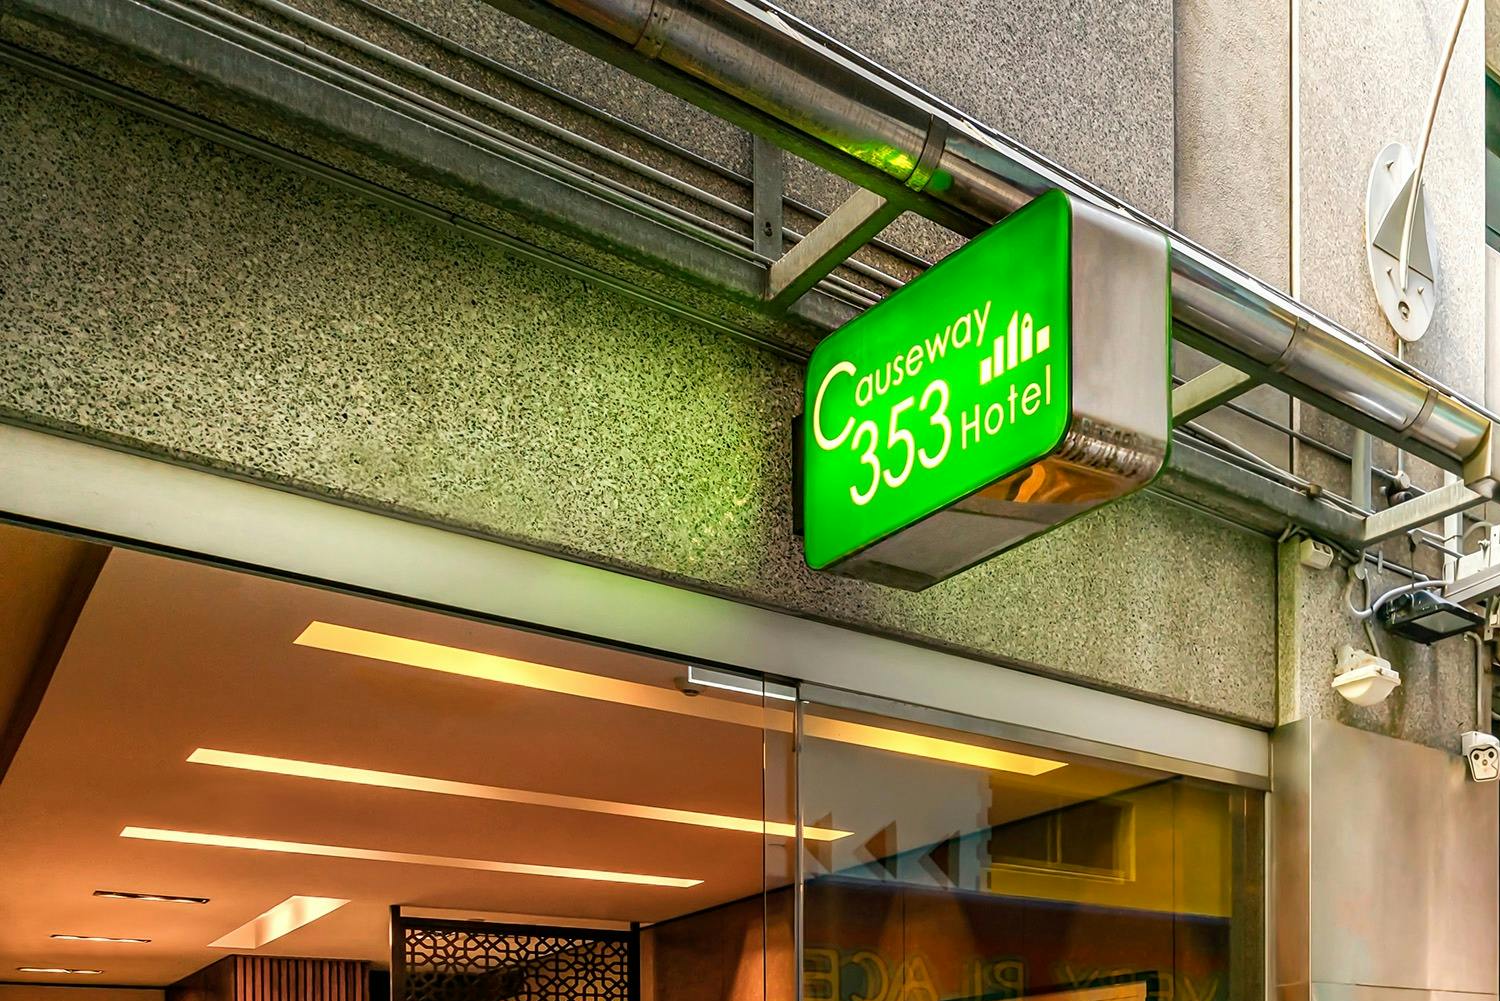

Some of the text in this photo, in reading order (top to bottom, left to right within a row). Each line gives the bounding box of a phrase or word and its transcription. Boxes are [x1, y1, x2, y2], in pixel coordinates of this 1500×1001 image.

[812, 300, 993, 452] Causeway
[849, 363, 1053, 507] 353 Hotel
